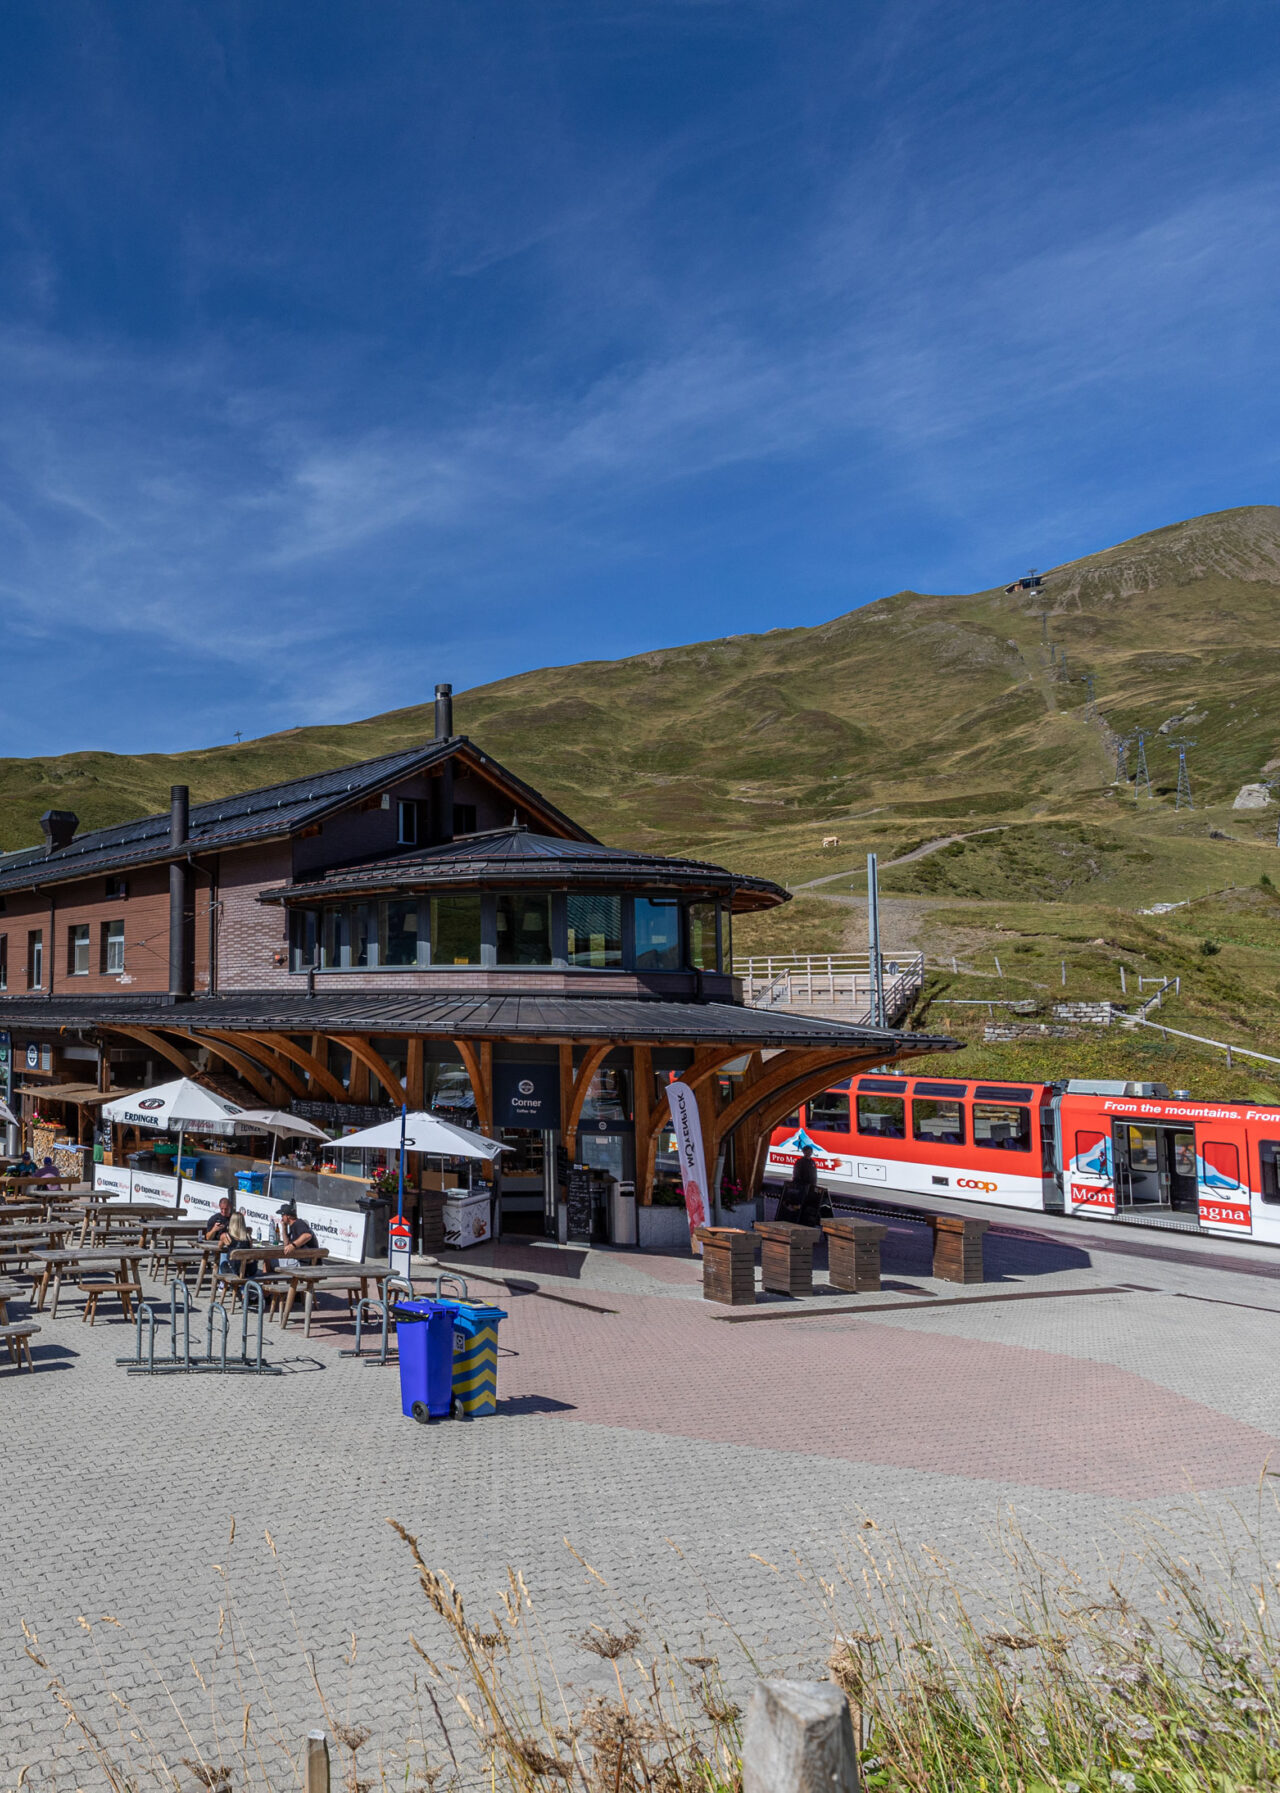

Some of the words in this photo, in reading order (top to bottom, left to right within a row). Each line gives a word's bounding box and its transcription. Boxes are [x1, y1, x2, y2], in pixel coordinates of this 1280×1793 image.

[511, 1097, 542, 1107] Corner
[1104, 1101, 1137, 1112] From
[1140, 1103, 1161, 1114] the
[1165, 1105, 1241, 1120] mountains.
[124, 1111, 159, 1126] ERDINGER
[772, 1154, 785, 1162] Pro
[956, 1177, 998, 1193] coop
[1072, 1187, 1115, 1204] Mont
[246, 1210, 269, 1221] ERDINGER
[1199, 1206, 1245, 1221] agna
[310, 1222, 338, 1236] ERDINGER
